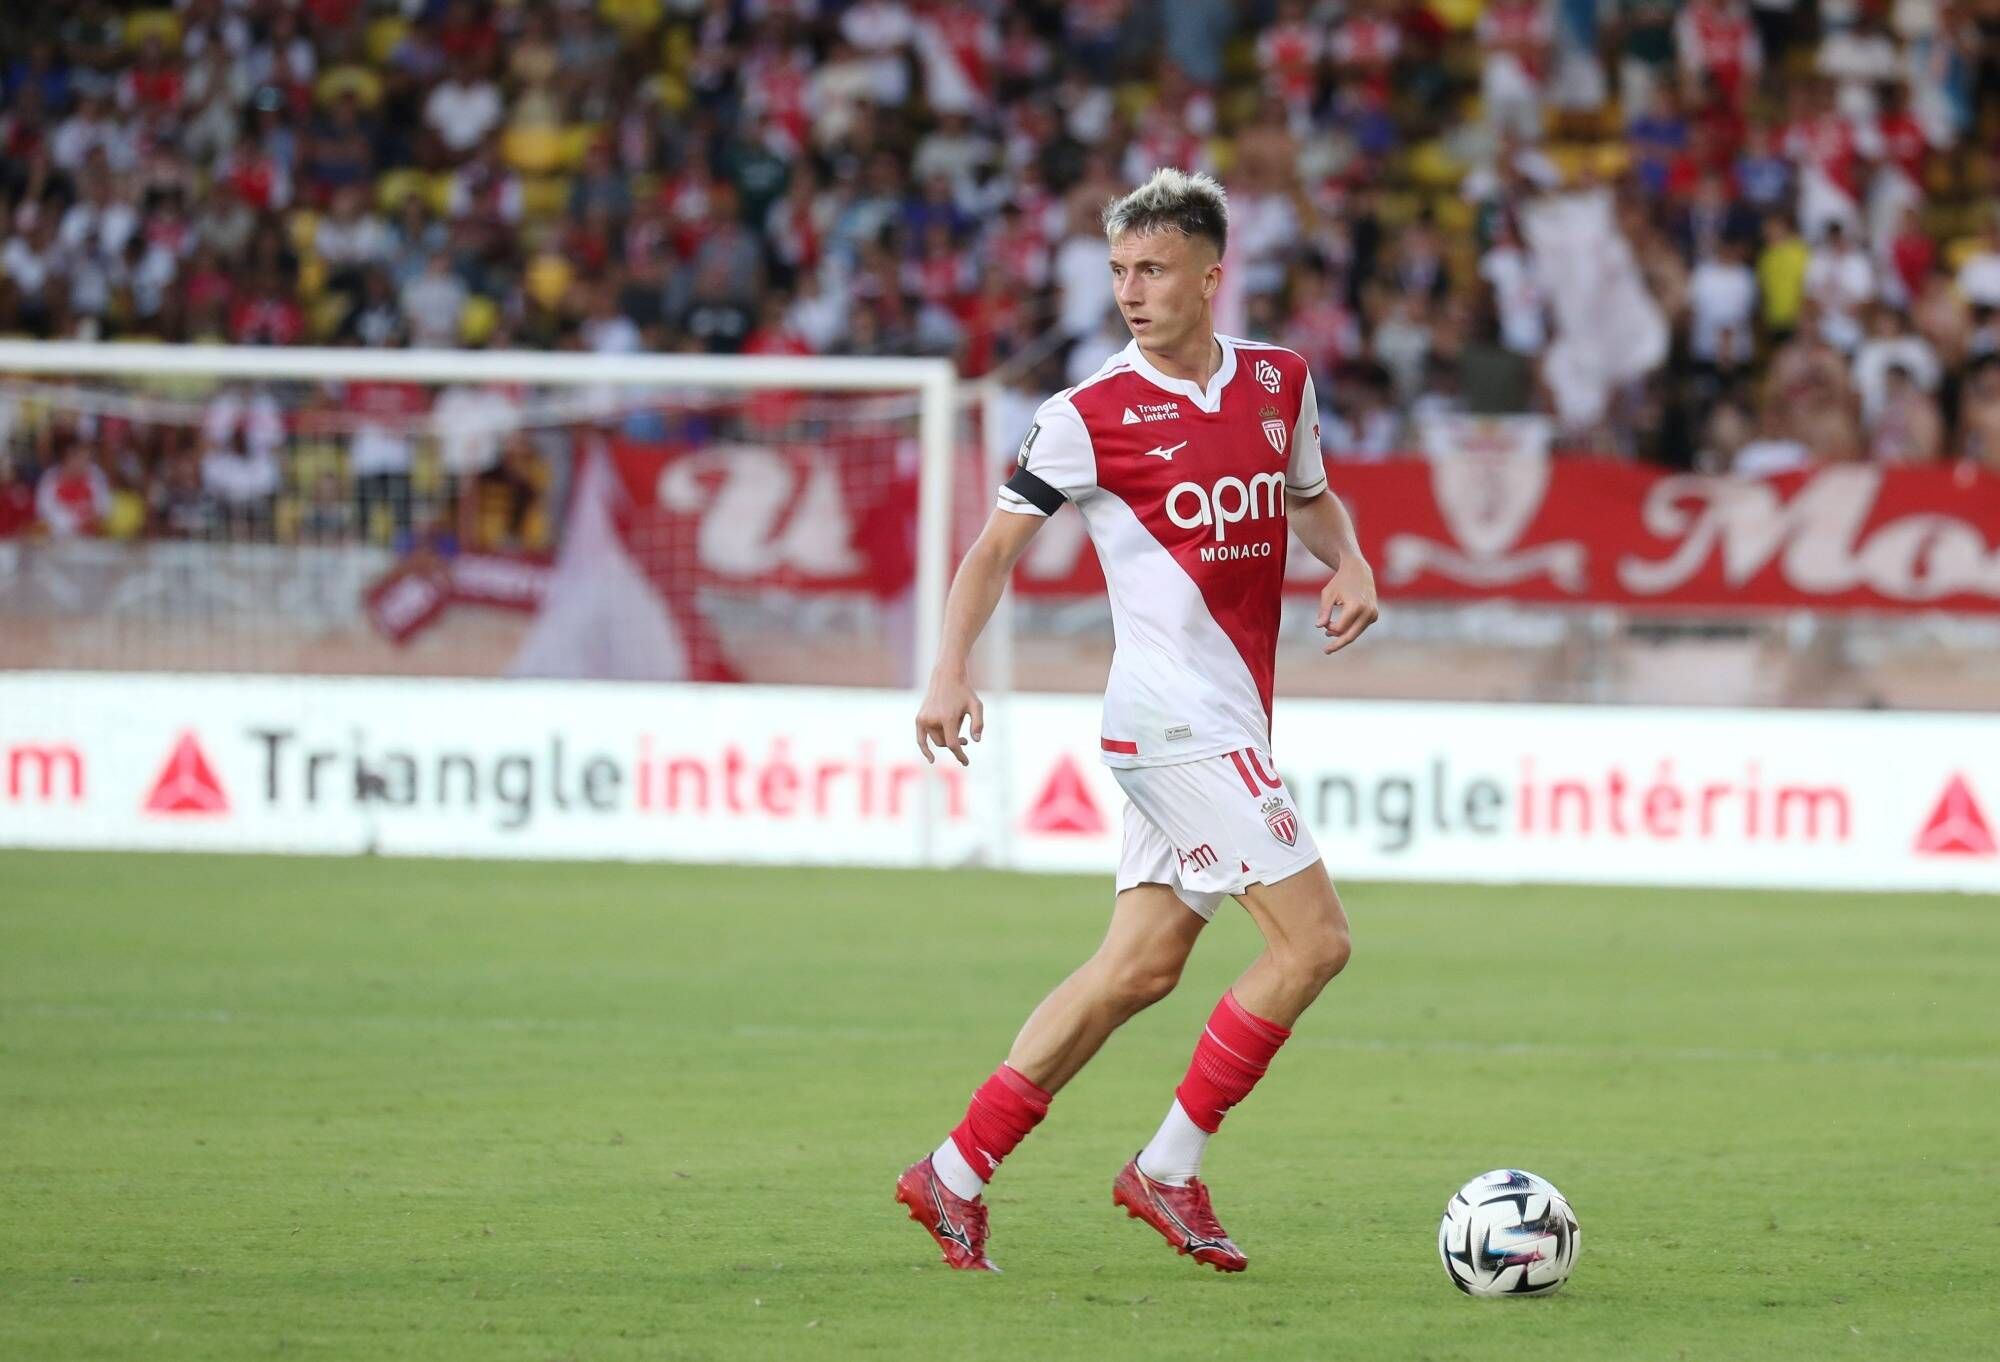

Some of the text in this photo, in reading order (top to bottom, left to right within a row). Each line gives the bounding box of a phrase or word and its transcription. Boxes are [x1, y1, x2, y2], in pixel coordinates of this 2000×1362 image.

[1137, 402, 1178, 413] Triangle
[1165, 471, 1286, 541] apm
[1200, 542, 1271, 562] MONACO
